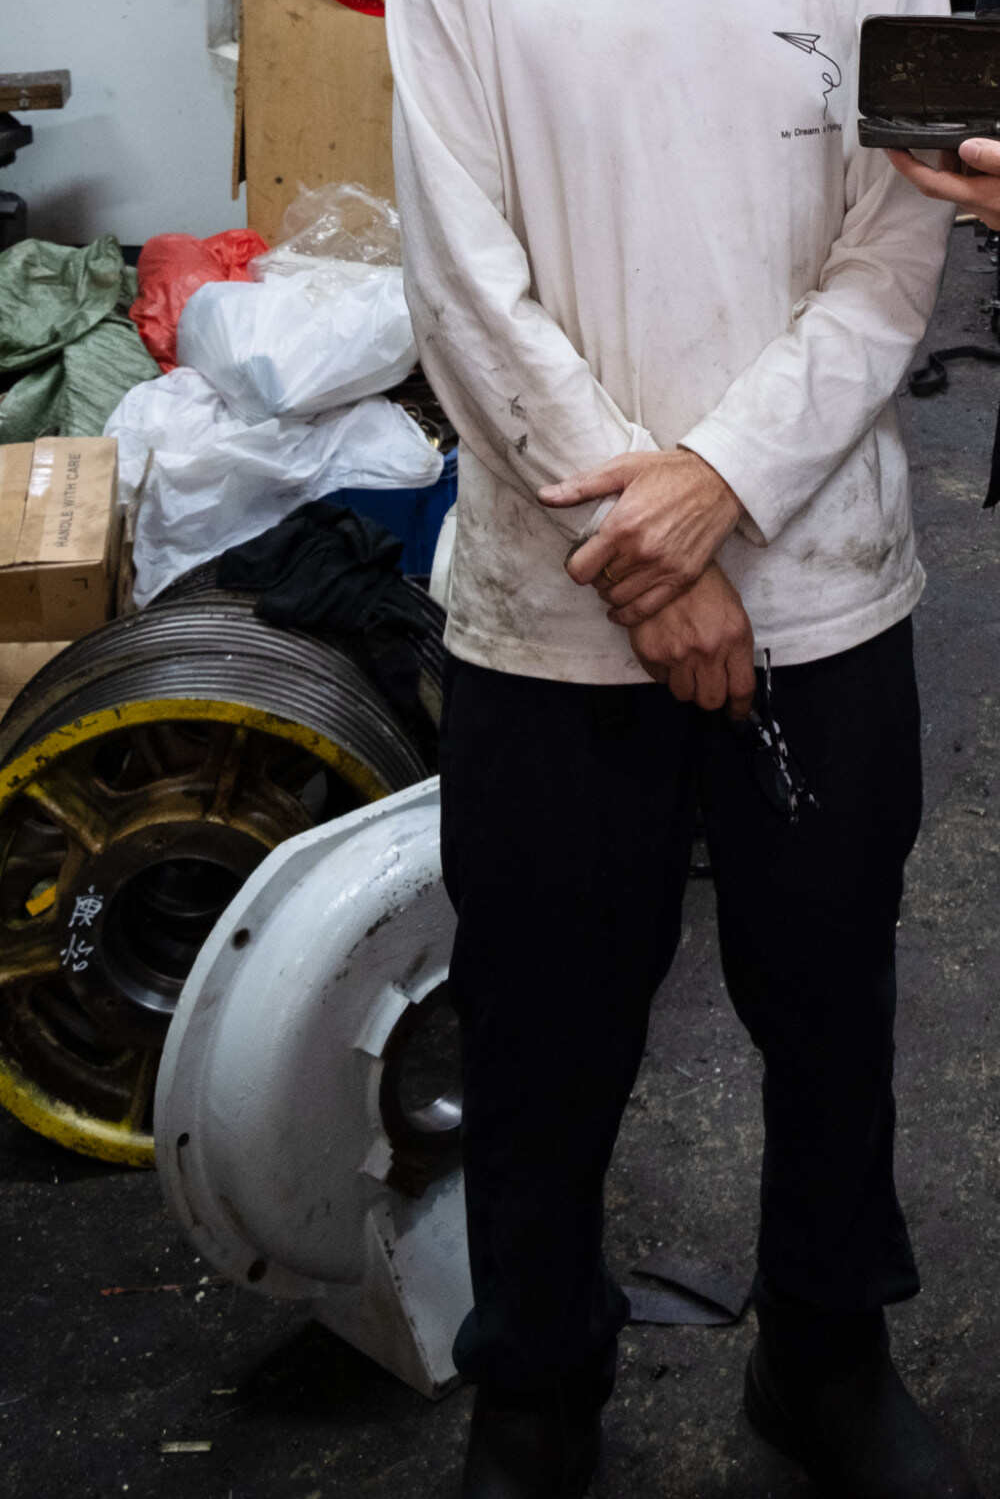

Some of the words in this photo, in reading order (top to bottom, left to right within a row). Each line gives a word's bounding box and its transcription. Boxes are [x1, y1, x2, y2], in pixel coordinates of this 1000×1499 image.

[794, 127, 820, 137] Dream
[66, 453, 81, 480] CARE
[63, 482, 77, 508] WITH
[56, 510, 74, 548] HANDLE
